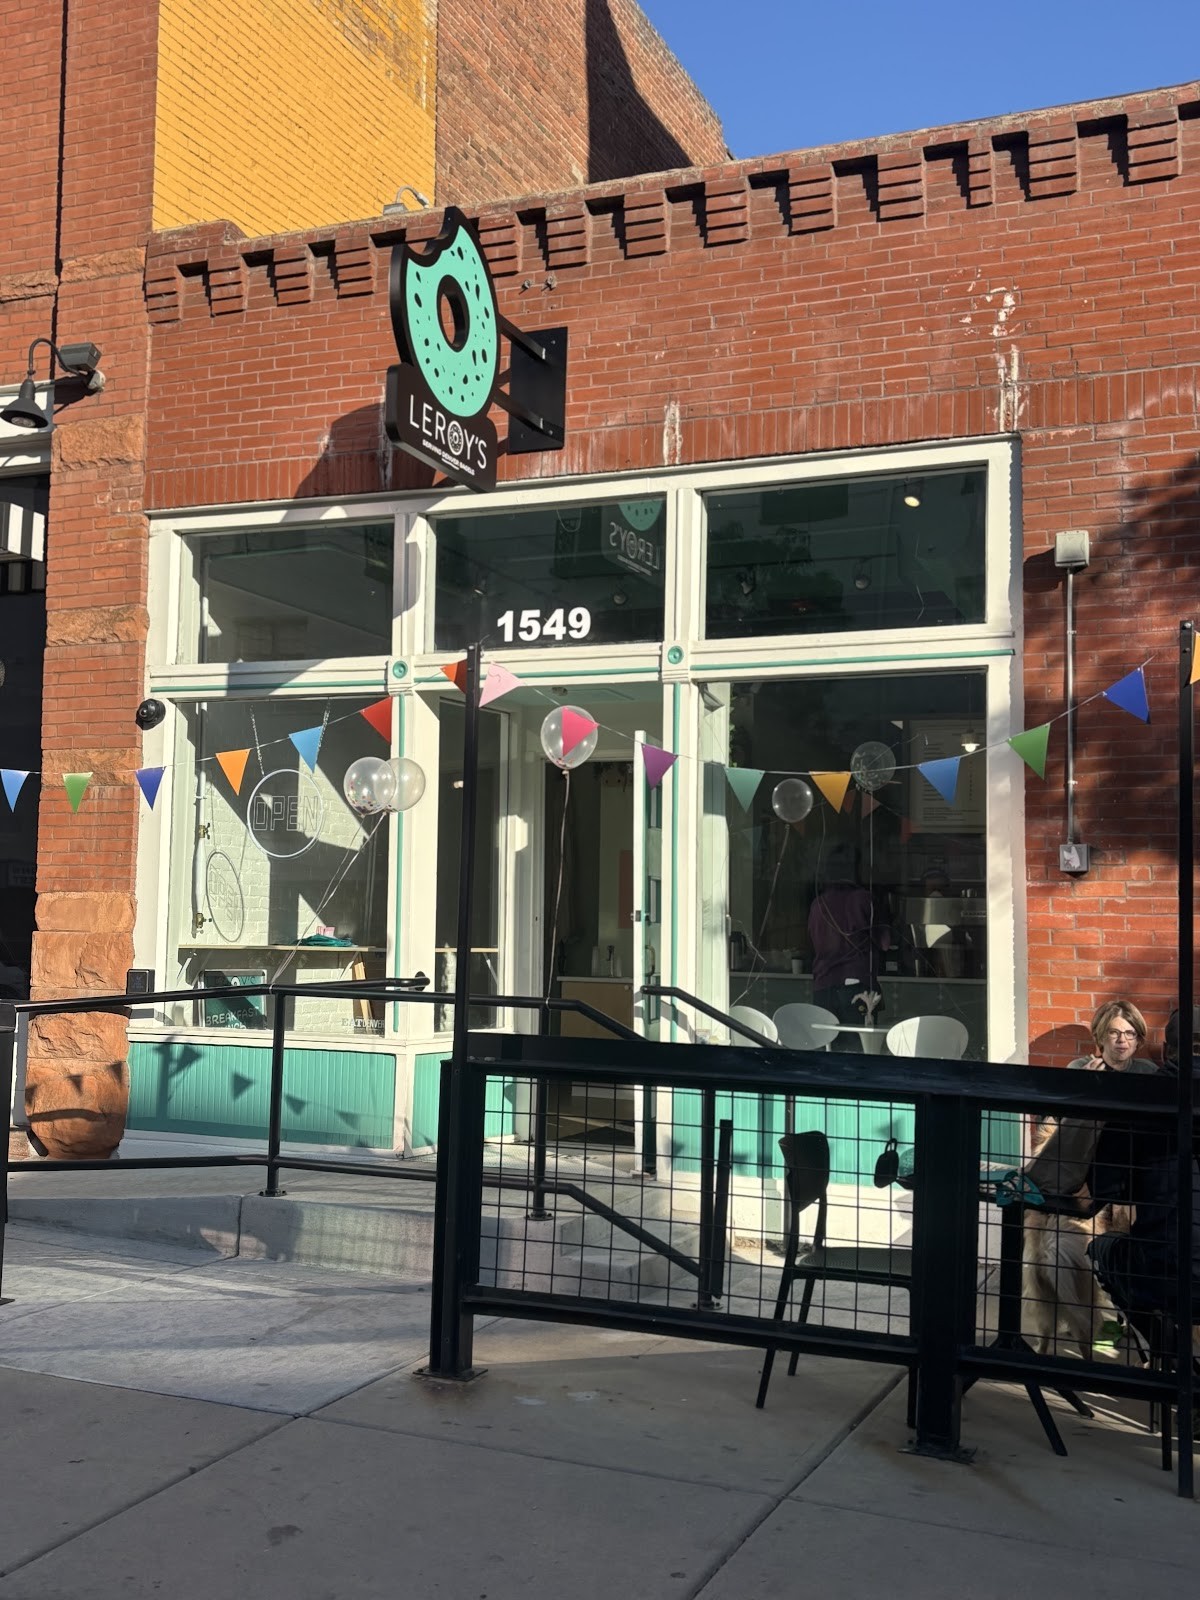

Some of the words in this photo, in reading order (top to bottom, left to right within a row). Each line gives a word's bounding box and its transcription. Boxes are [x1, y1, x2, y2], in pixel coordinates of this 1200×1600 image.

[410, 394, 487, 469] LEROY'S
[497, 606, 591, 642] 1549
[252, 795, 319, 831] OPEN
